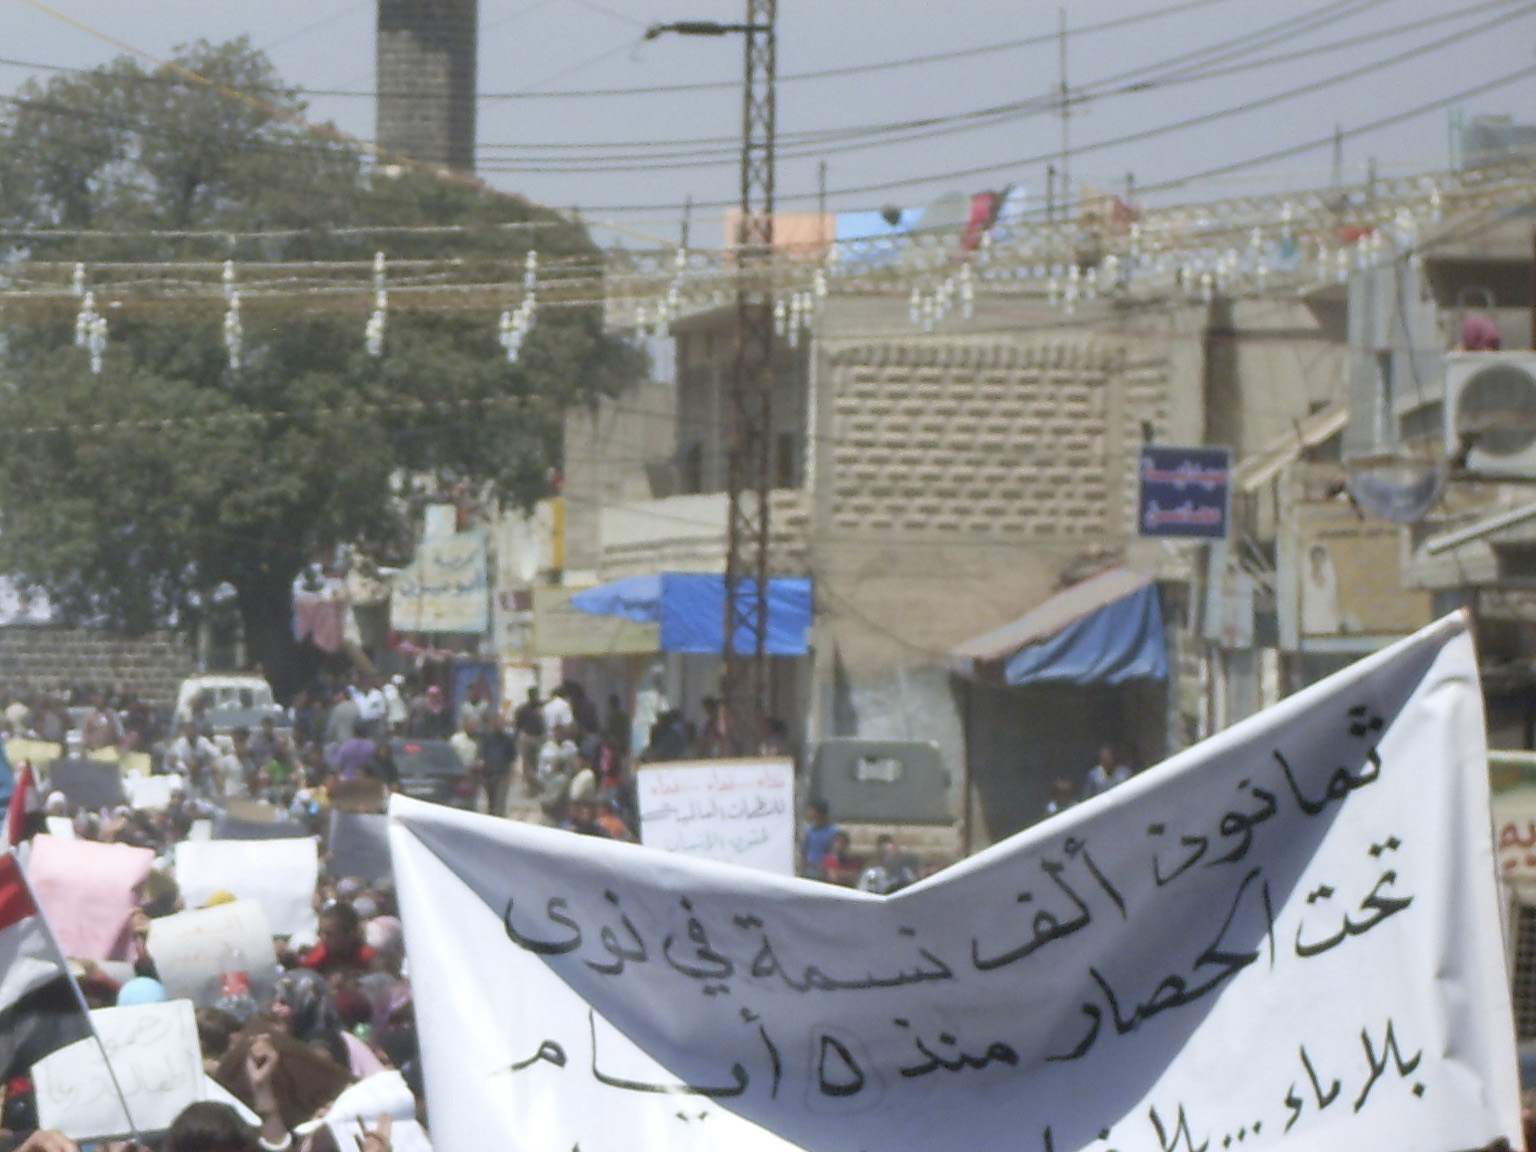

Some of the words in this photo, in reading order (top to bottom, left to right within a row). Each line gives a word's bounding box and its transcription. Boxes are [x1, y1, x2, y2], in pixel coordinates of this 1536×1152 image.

[1152, 705, 1384, 886] ثمانون
[663, 897, 734, 996] في
[734, 913, 954, 993] نسمة
[971, 836, 1127, 971] ألف
[1294, 836, 1414, 958] تحت
[1045, 866, 1275, 1063] الحصار
[490, 1006, 781, 1122] أيام
[895, 1018, 1019, 1077] منذ
[1354, 1018, 1424, 1114] بلا
